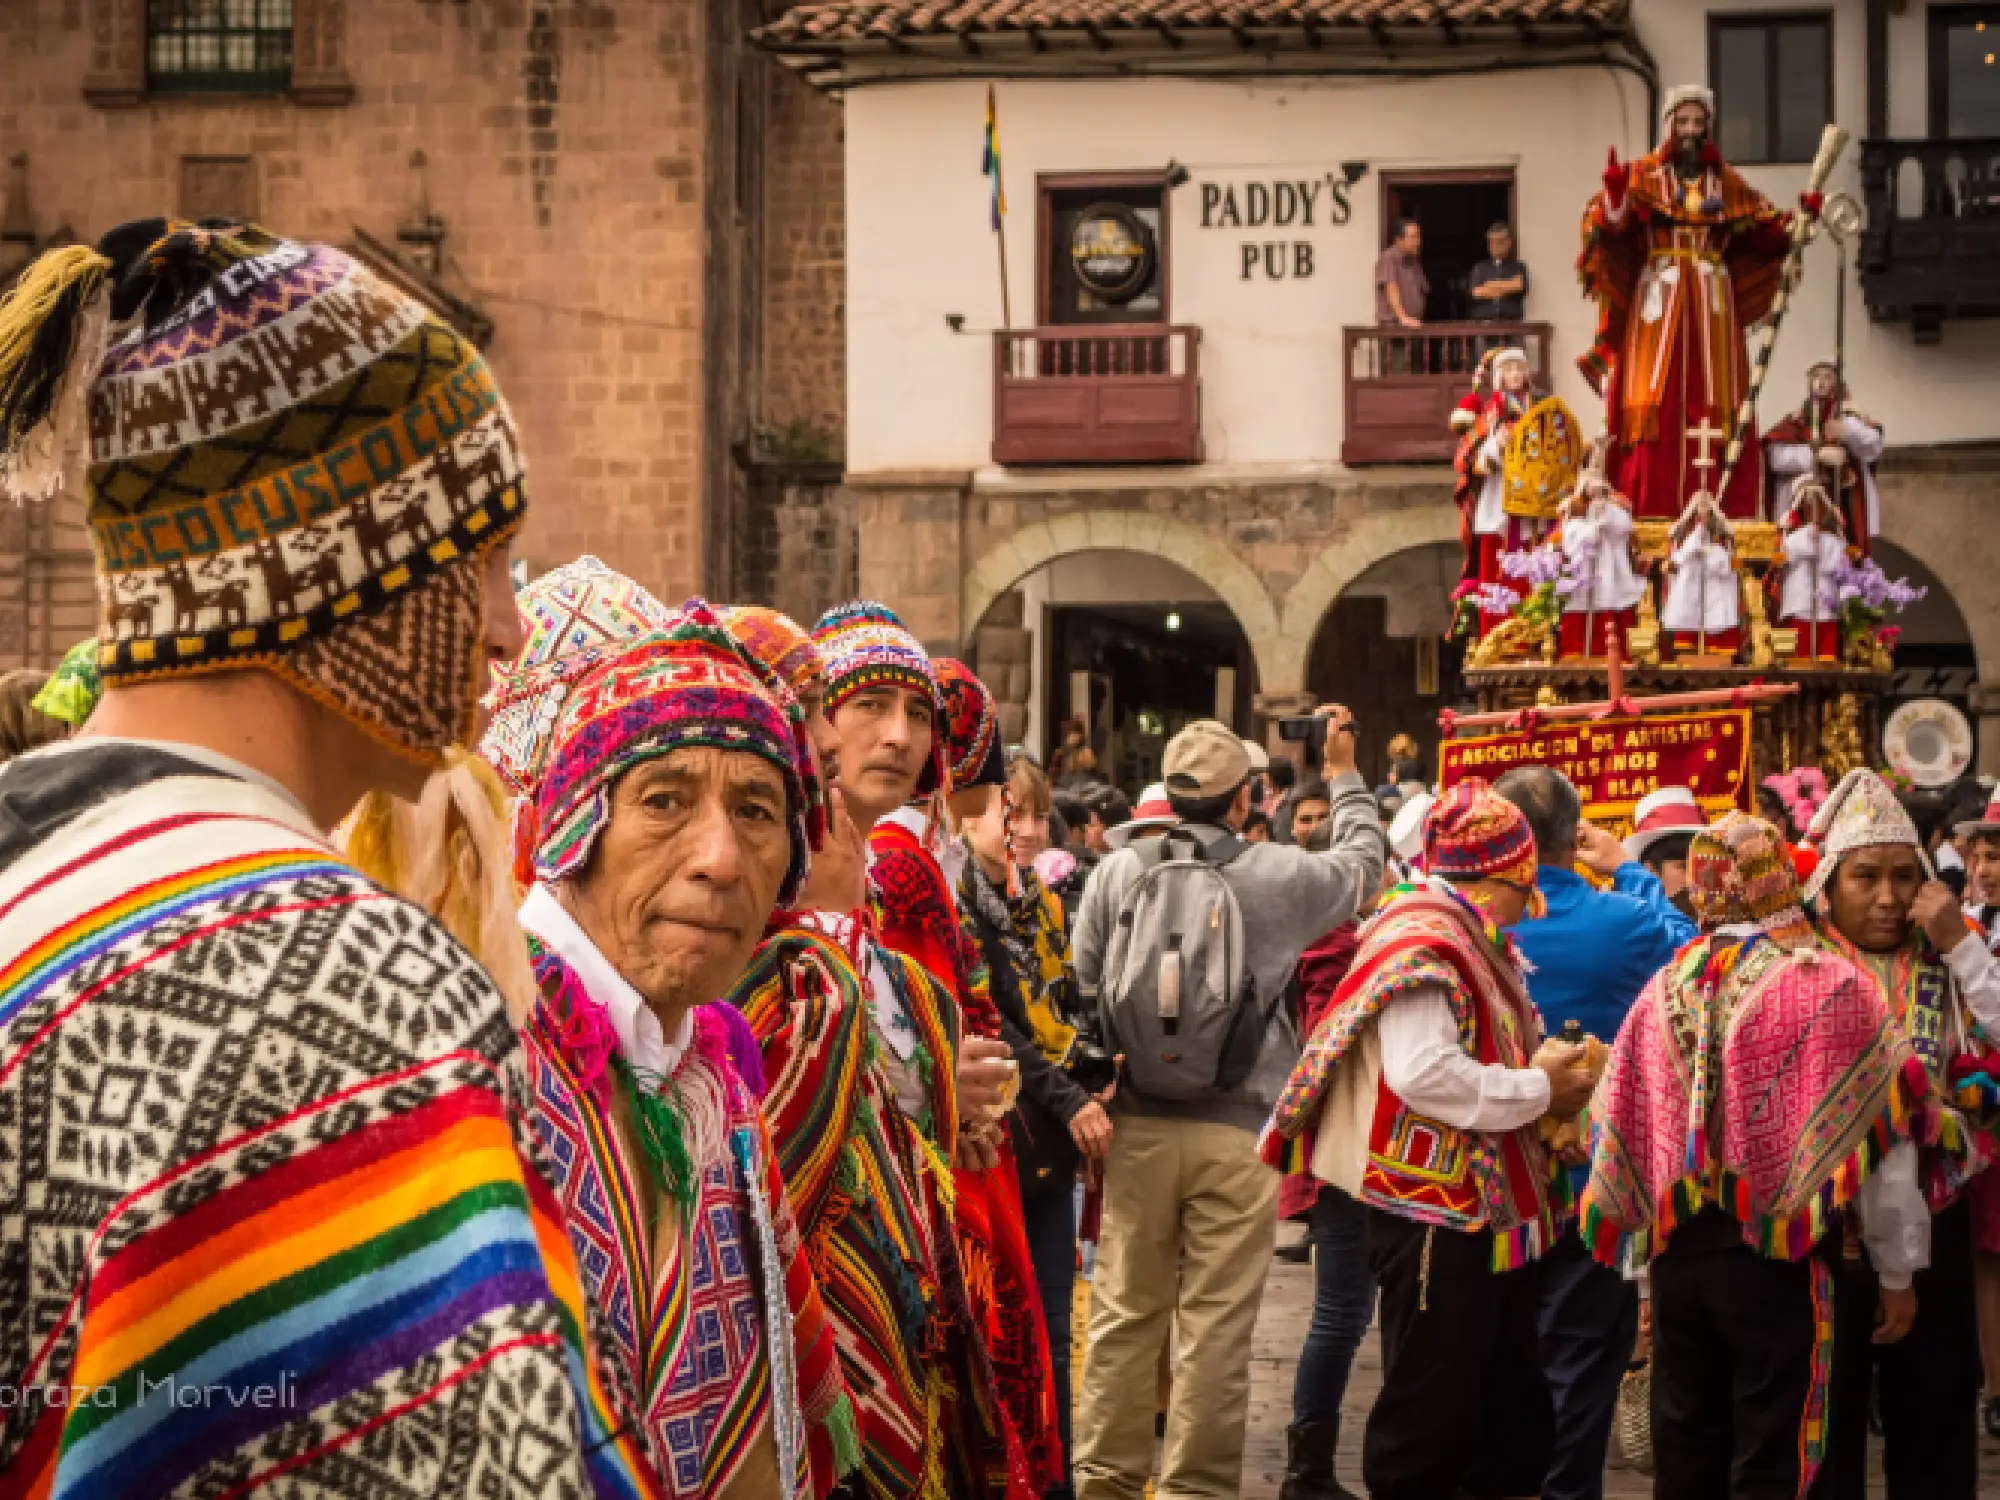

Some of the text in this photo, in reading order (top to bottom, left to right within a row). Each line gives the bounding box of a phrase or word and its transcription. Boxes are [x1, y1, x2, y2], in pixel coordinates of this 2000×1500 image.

[1200, 172, 1351, 227] PADDY'S
[1240, 241, 1314, 281] PUB
[102, 506, 219, 571] USCO
[217, 432, 401, 541] CUSCO
